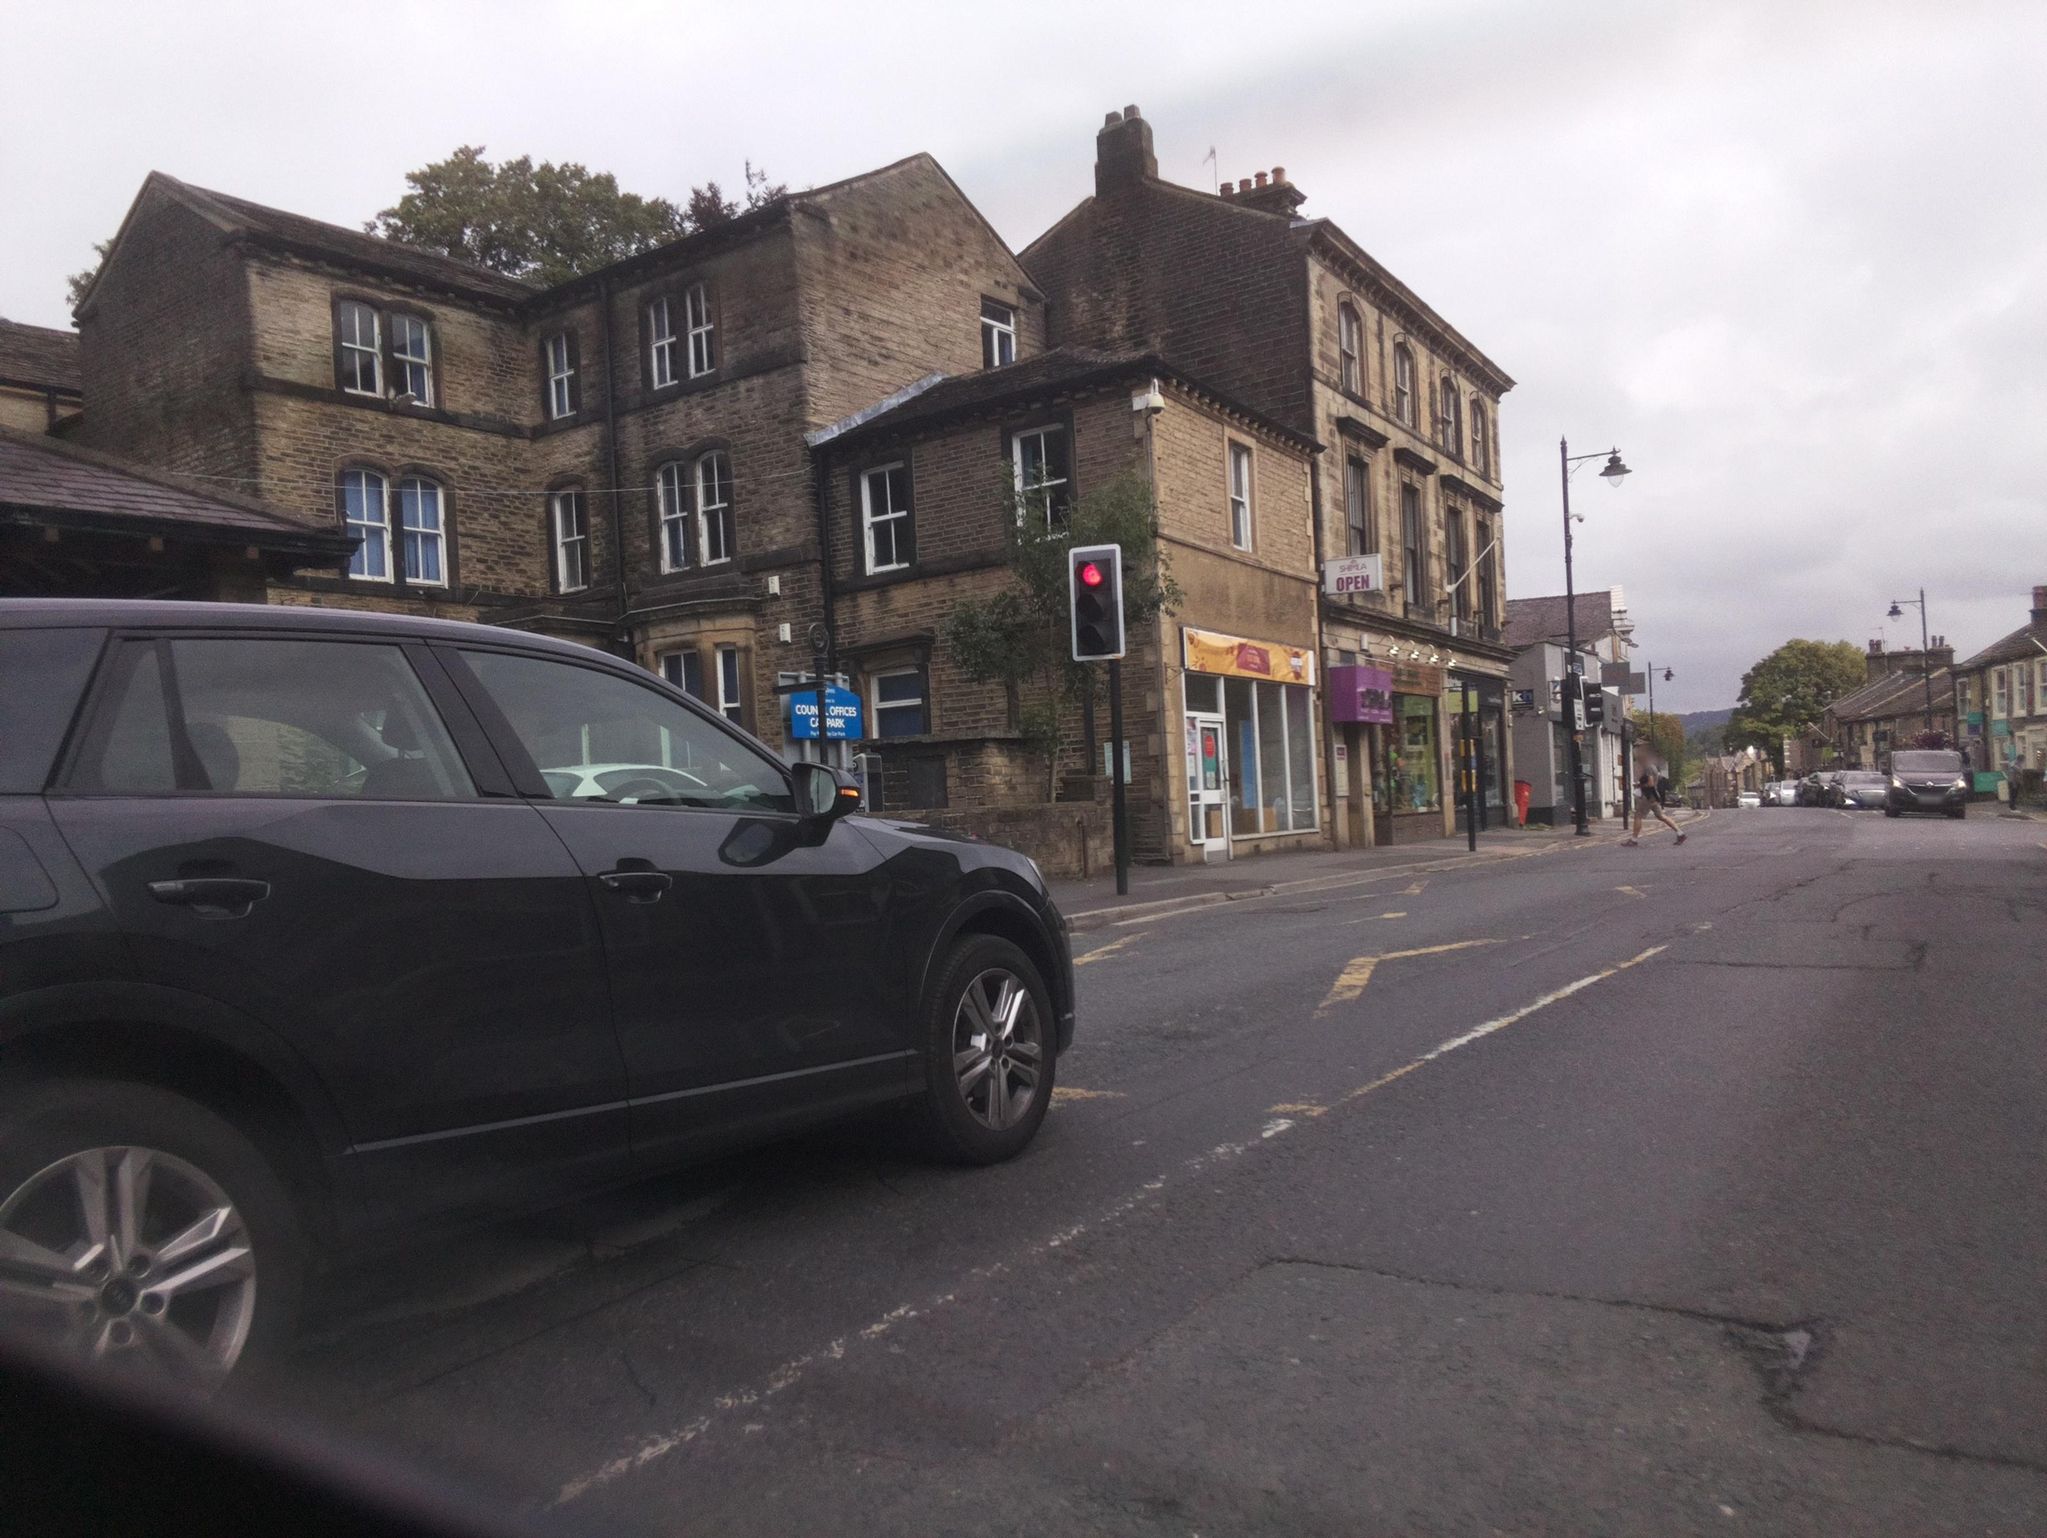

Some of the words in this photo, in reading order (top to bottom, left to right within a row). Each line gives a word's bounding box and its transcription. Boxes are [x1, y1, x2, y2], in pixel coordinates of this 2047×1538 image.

[1336, 574, 1370, 592] OPEN
[795, 704, 829, 716] COUN
[829, 706, 857, 717] OFFICES
[826, 718, 845, 728] PARK
